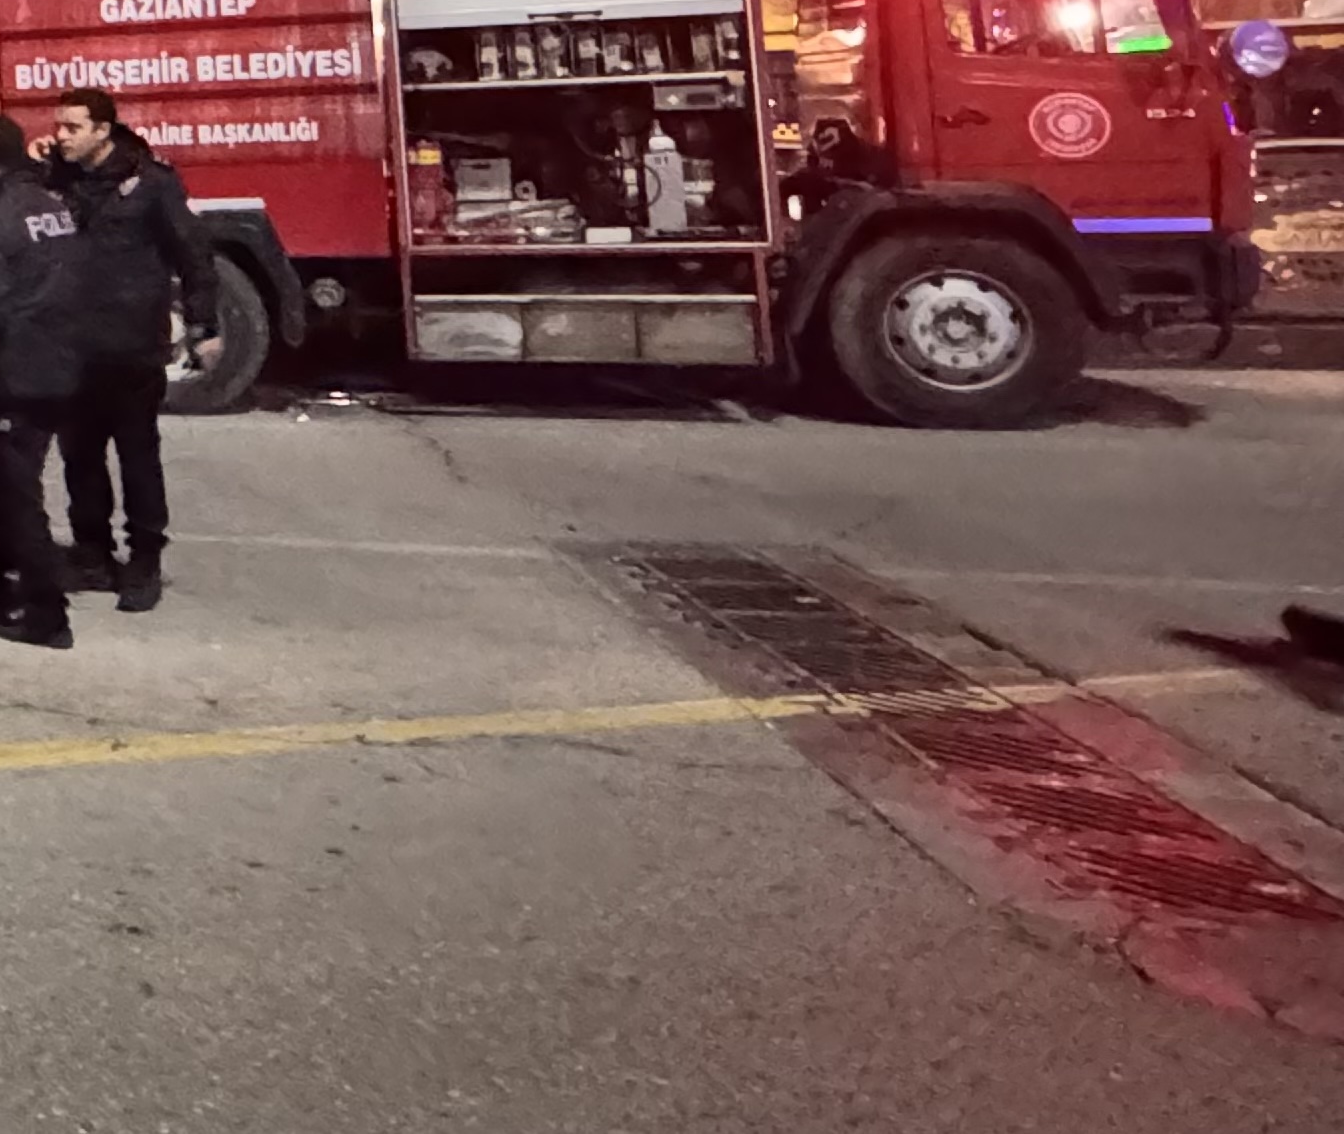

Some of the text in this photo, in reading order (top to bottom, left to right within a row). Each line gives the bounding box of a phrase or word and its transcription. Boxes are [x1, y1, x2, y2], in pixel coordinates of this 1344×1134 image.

[15, 41, 362, 93] BÜYÜKŞEHİR BELEDİYESİ
[198, 117, 319, 149] BAŞKANLIĞI
